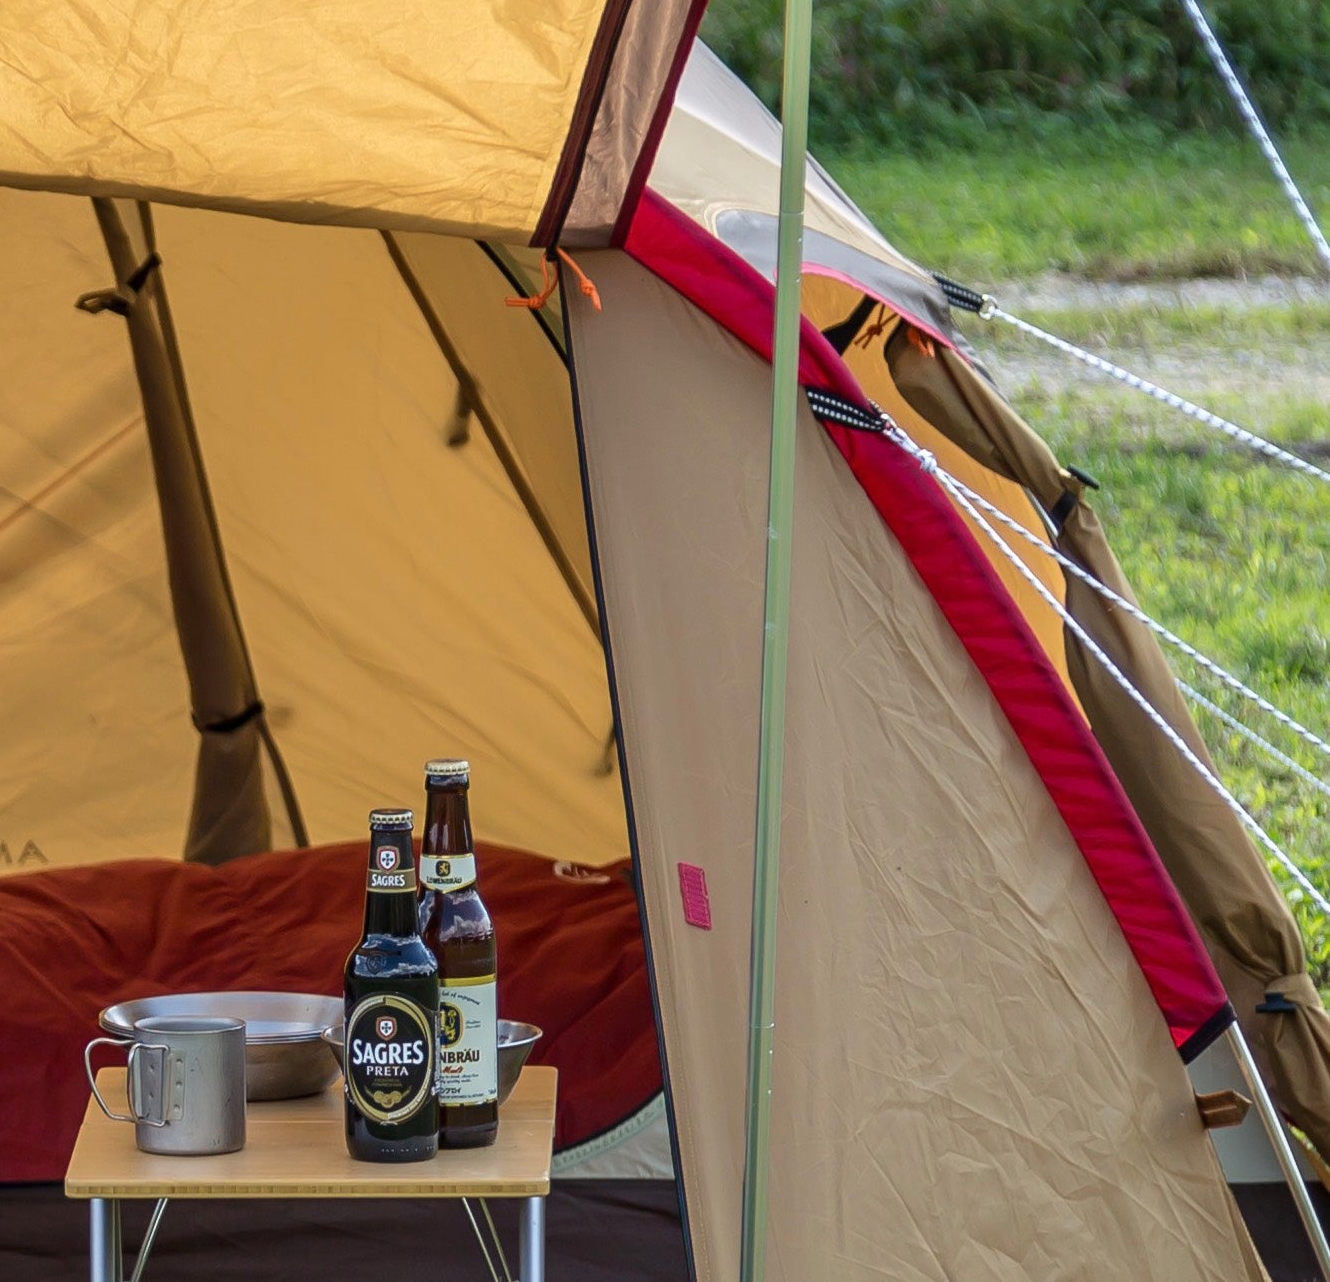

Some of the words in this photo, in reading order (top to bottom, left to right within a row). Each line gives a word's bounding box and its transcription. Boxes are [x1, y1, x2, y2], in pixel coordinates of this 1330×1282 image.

[371, 873, 406, 887] SAGRES
[352, 1038, 424, 1065] SAGRES
[366, 1065, 409, 1077] PRETA
